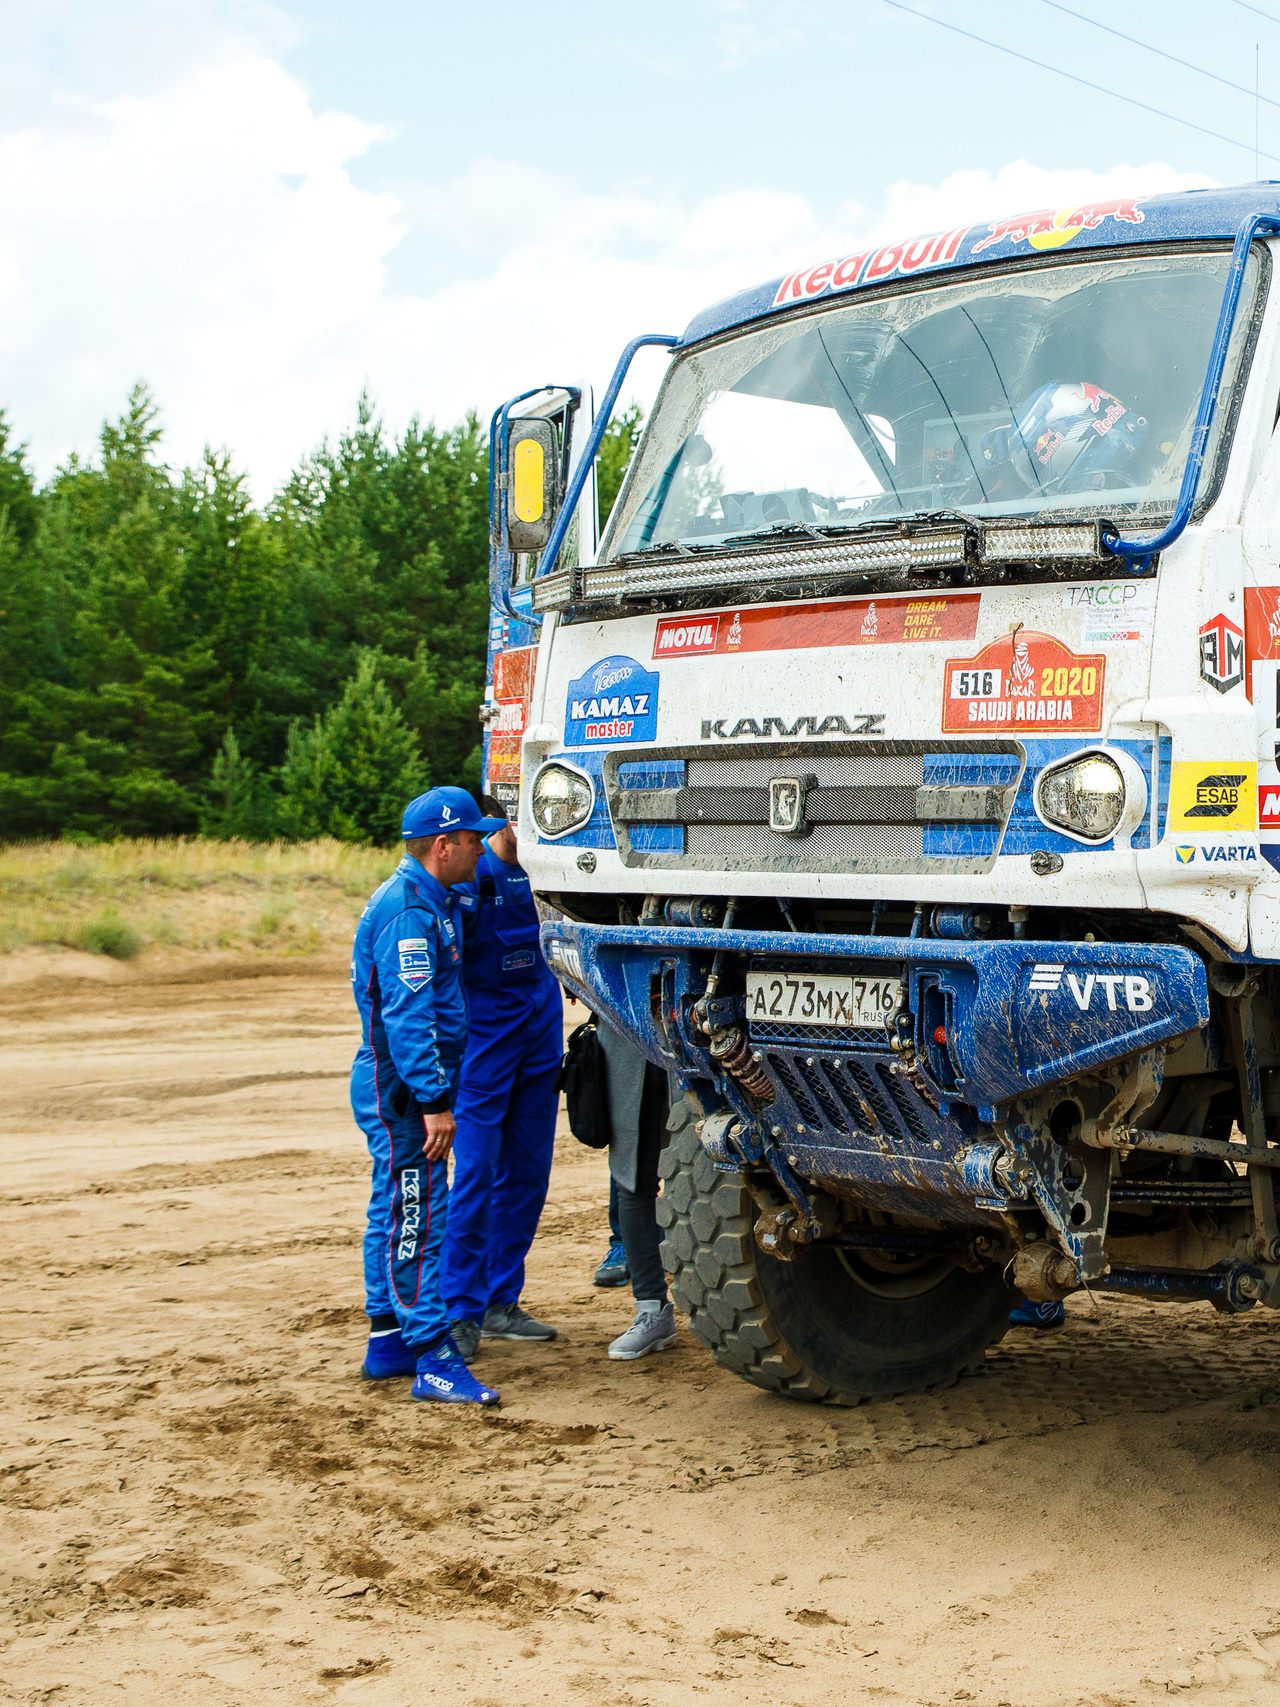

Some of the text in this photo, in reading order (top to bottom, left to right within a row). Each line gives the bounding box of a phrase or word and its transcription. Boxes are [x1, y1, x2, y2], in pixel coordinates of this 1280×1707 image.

[774, 225, 971, 305] Red Bull
[1039, 432, 1064, 465] Red Bull
[906, 601, 947, 613] DREAM.
[658, 625, 713, 649] MOTUL
[902, 626, 942, 639] LIVE IT.
[593, 661, 632, 695] Team
[959, 672, 992, 696] 516
[1005, 679, 1036, 698] DAKAR
[1040, 667, 1097, 697] 2020
[571, 693, 651, 722] KAMAZ
[968, 700, 1073, 721] SAUDI ARABIA
[585, 719, 633, 740] master
[701, 713, 886, 740] KAMAZ
[1196, 788, 1239, 804] ESAB
[1200, 846, 1257, 862] VARTA
[855, 981, 894, 1011] 716
[1067, 973, 1153, 1012] VTB
[863, 1011, 882, 1022] RUS
[398, 1169, 420, 1260] KAMAZ
